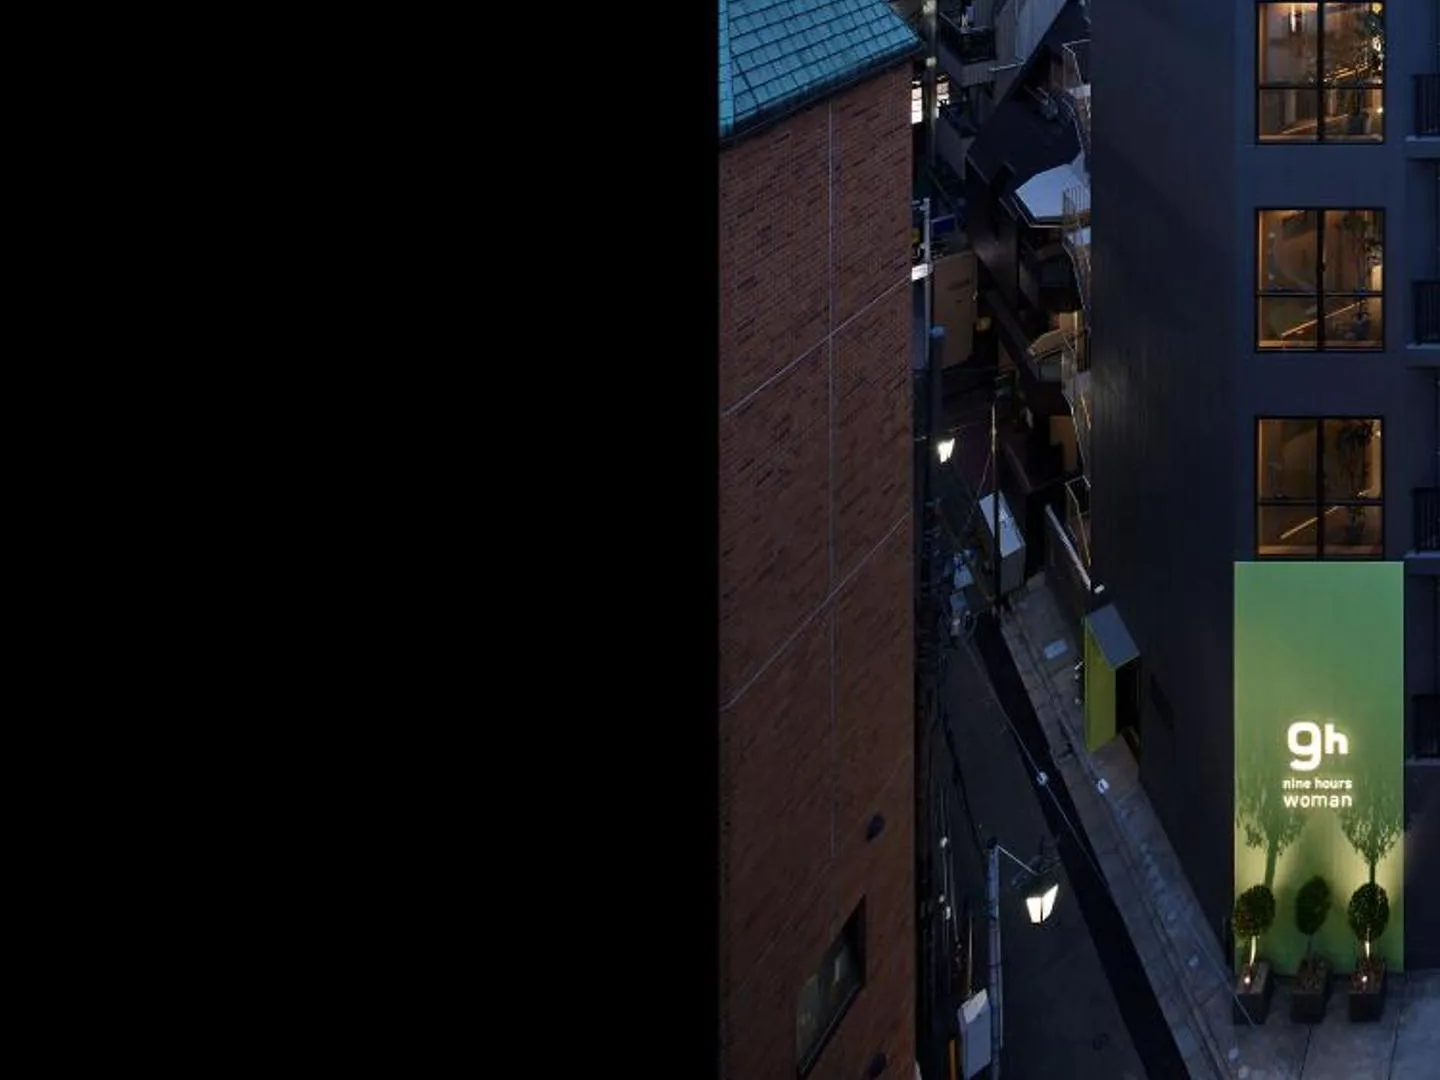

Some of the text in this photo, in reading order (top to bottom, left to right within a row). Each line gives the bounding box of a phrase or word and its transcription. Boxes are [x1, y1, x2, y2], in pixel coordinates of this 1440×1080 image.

[1287, 721, 1349, 772] 9h
[1282, 777, 1353, 790] nine hours
[1282, 794, 1353, 809] woman
